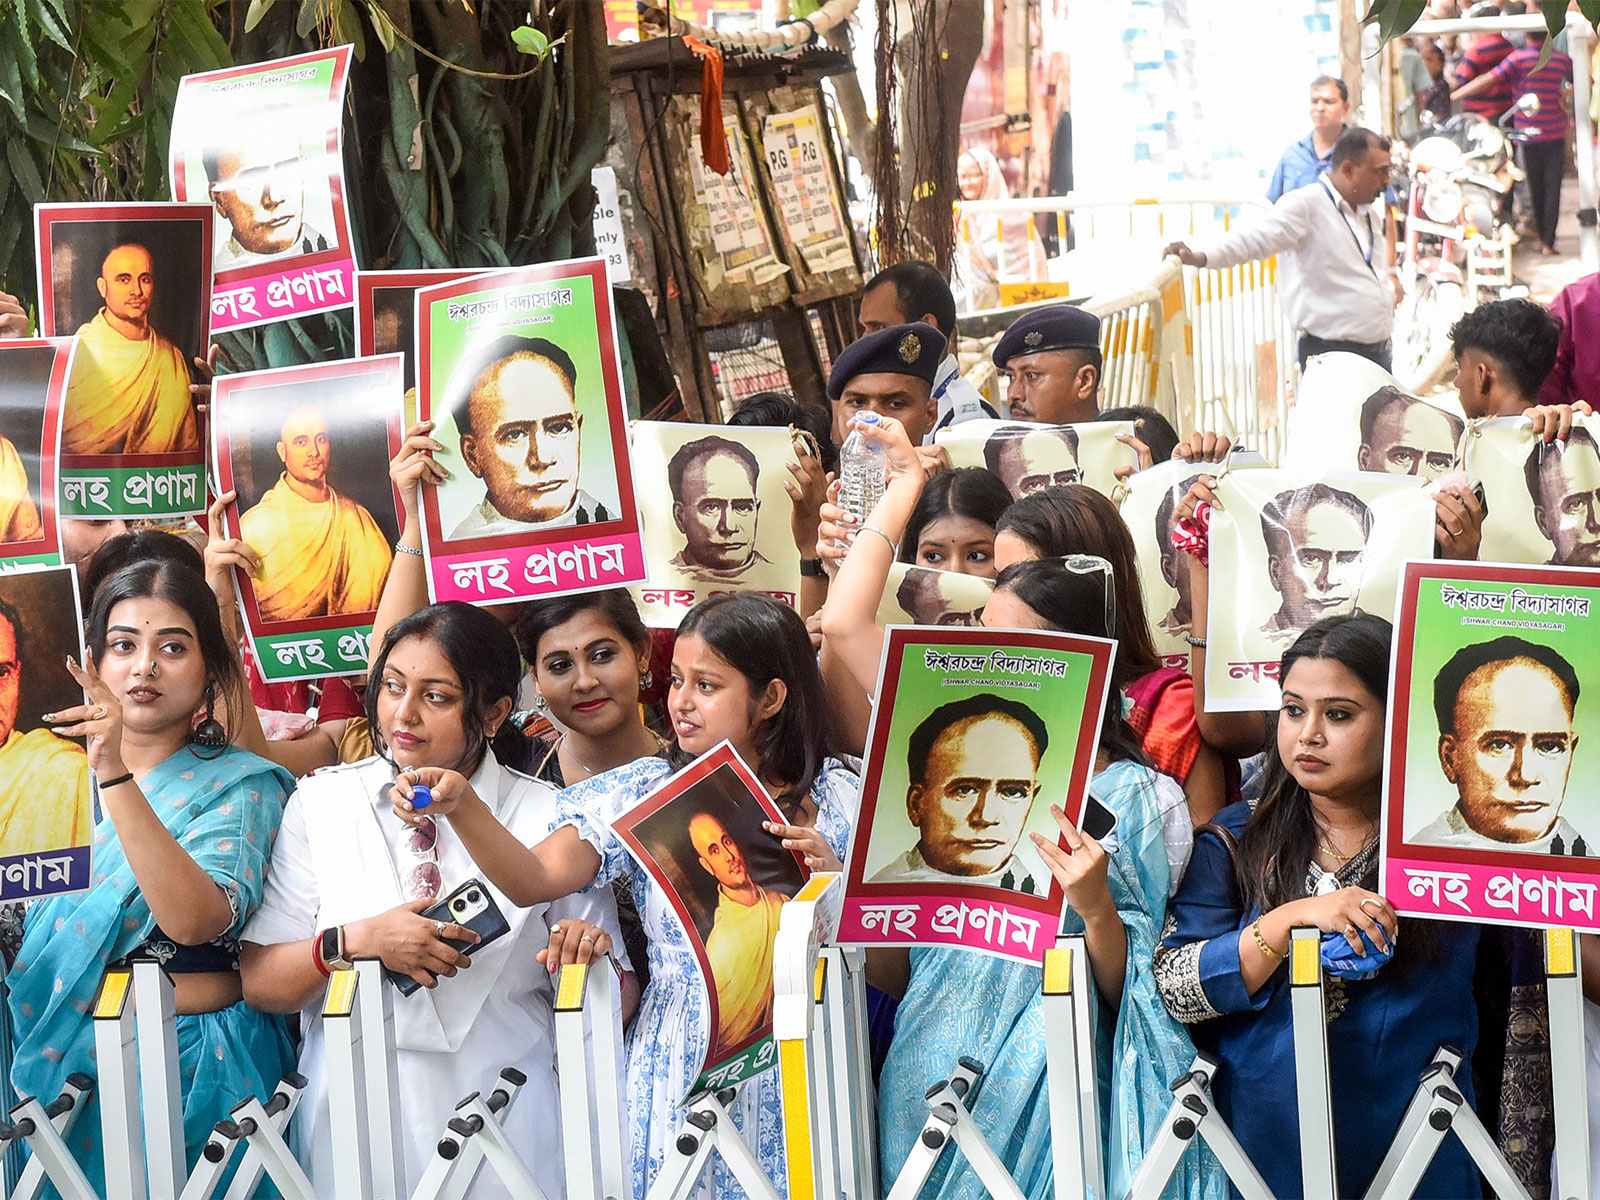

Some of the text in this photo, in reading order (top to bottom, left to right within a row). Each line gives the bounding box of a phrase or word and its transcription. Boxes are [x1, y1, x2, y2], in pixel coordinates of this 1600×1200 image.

[770, 149, 788, 170] P.G
[802, 141, 817, 161] P.G
[598, 232, 618, 244] nly
[212, 269, 346, 319] লহ প্রণাম
[503, 288, 572, 312] বিদ্যাসাগর
[61, 469, 197, 512] লহ প্রণাম
[448, 542, 625, 595] লহ প্রণাম
[641, 589, 695, 607] লহ
[1442, 583, 1590, 616] ঈশ্বরচন্দ্র বিদ্যাসাগর
[1461, 617, 1565, 631] (ISHWAR CHAND VIDYASAGAR)
[270, 638, 334, 670] লহ
[925, 649, 1068, 678] ঈশ্বরচন্দ্র বিদ্যাসাগর
[971, 679, 994, 687] CHAND
[995, 680, 1041, 690] VIDYASAGAR)
[0, 855, 74, 895] ণাম
[1403, 868, 1598, 920] লহ প্রণাম
[859, 901, 1041, 953] লহ প্রণাম
